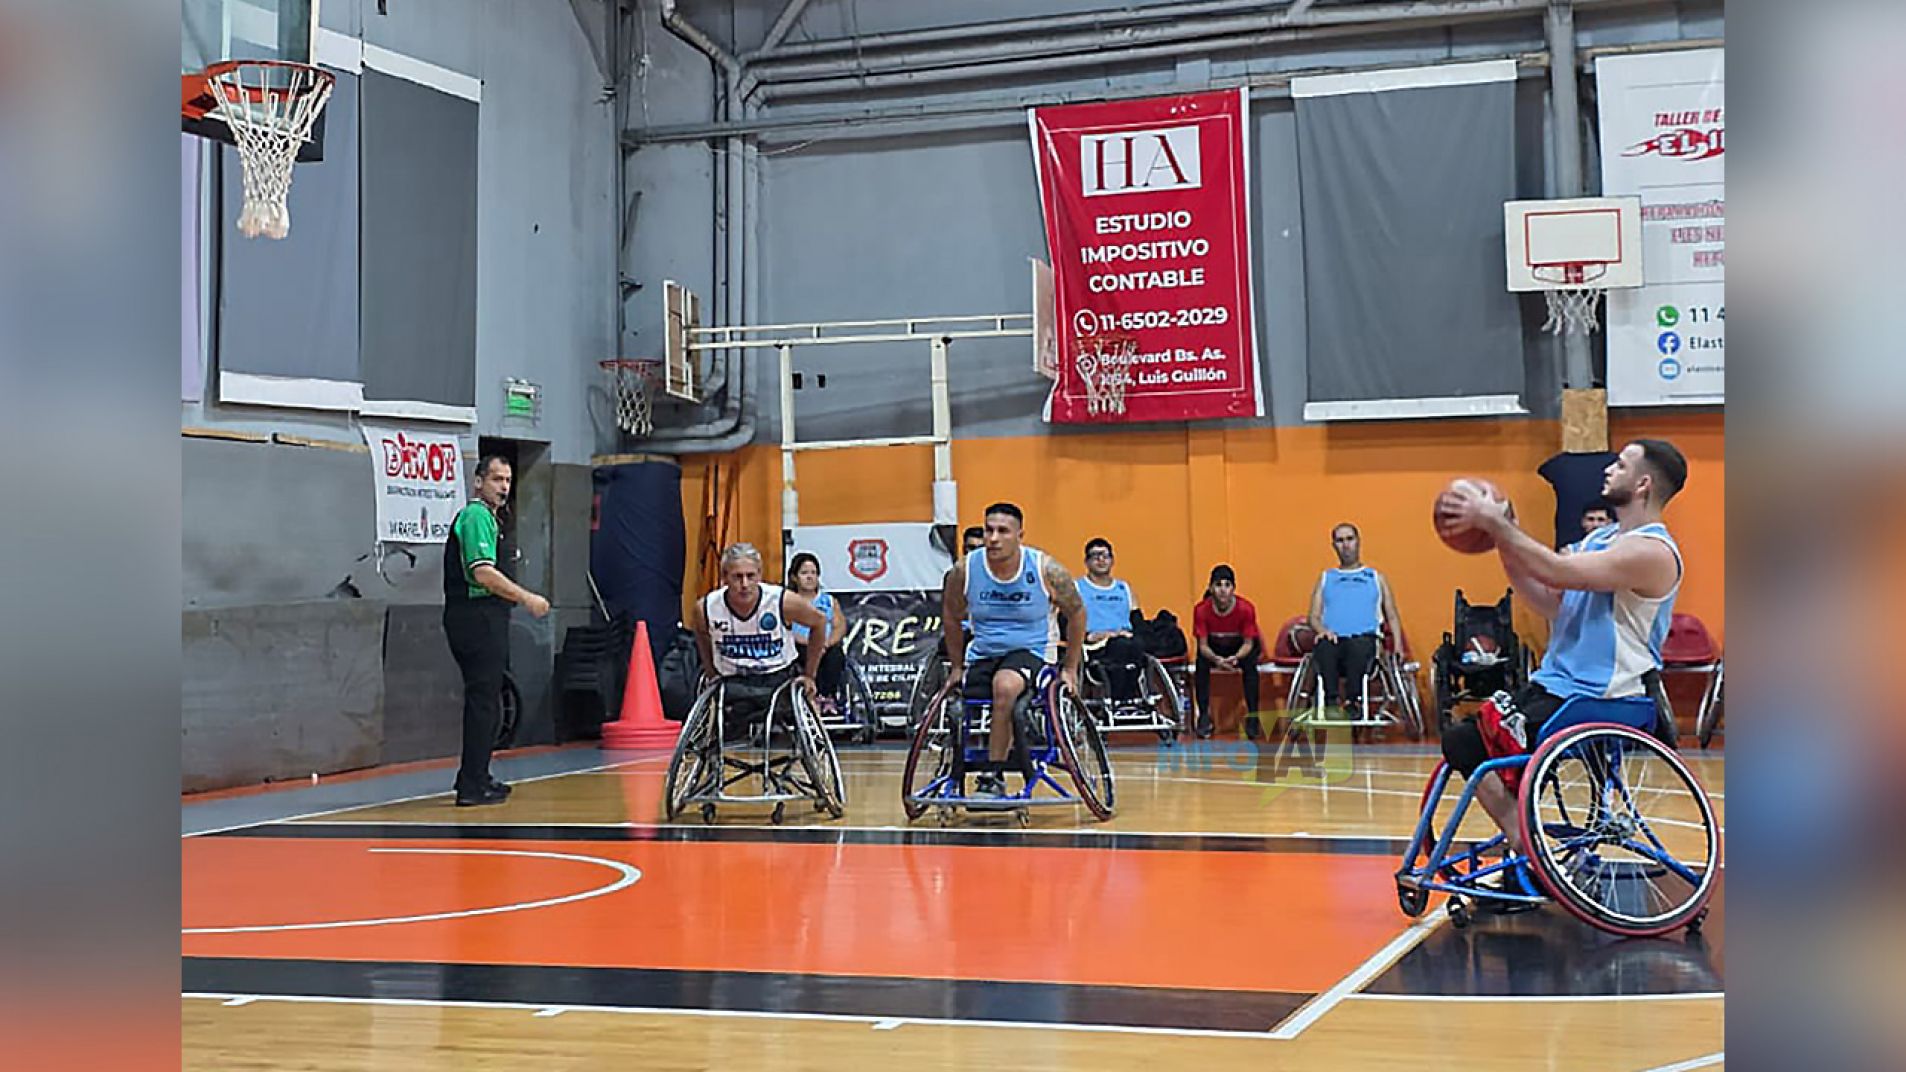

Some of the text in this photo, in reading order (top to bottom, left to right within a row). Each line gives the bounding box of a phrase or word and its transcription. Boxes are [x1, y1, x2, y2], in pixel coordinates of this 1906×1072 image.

[1655, 111, 1699, 127] TALLER
[1094, 134, 1190, 190] HA
[1095, 210, 1192, 234] ESTUDIO
[1080, 239, 1210, 264] IMPOSITIVO
[1089, 268, 1205, 293] CONTABLE
[1100, 307, 1228, 331] 11-6502-2029
[1690, 307, 1709, 323] 11
[1175, 349, 1198, 362] Bs.
[1202, 347, 1226, 361] As.
[1138, 370, 1169, 384] Luis
[1172, 368, 1227, 382] Guillón
